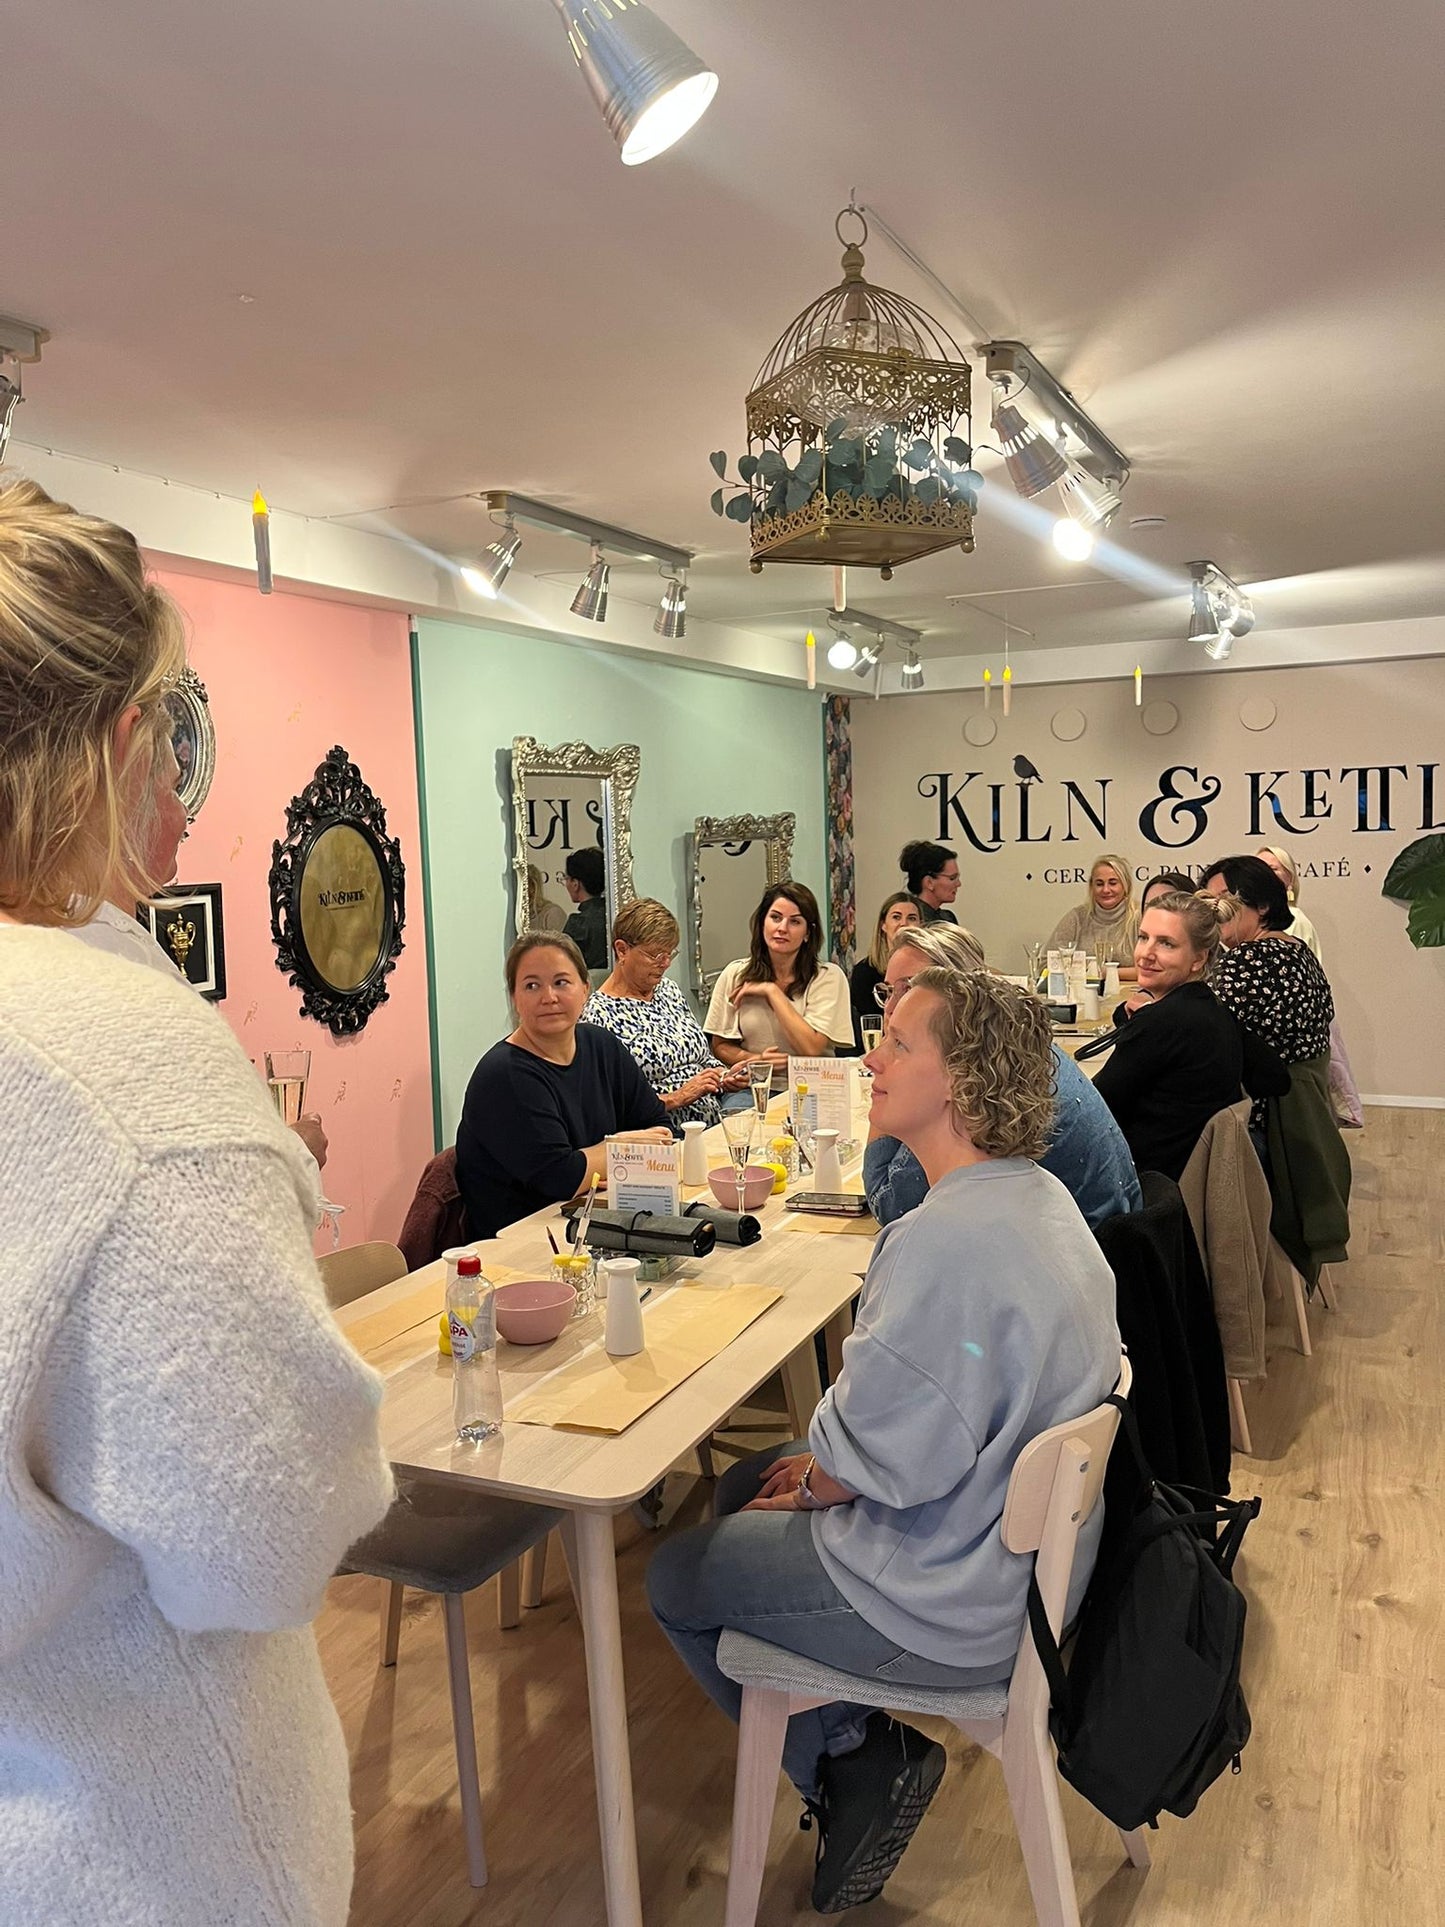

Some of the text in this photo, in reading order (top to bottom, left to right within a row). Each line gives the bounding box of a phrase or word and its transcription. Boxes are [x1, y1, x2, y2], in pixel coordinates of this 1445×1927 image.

[918, 772, 1113, 853] KILN
[1139, 766, 1222, 848] &
[1044, 865, 1150, 884] CERC
[646, 1159, 676, 1172] Menu
